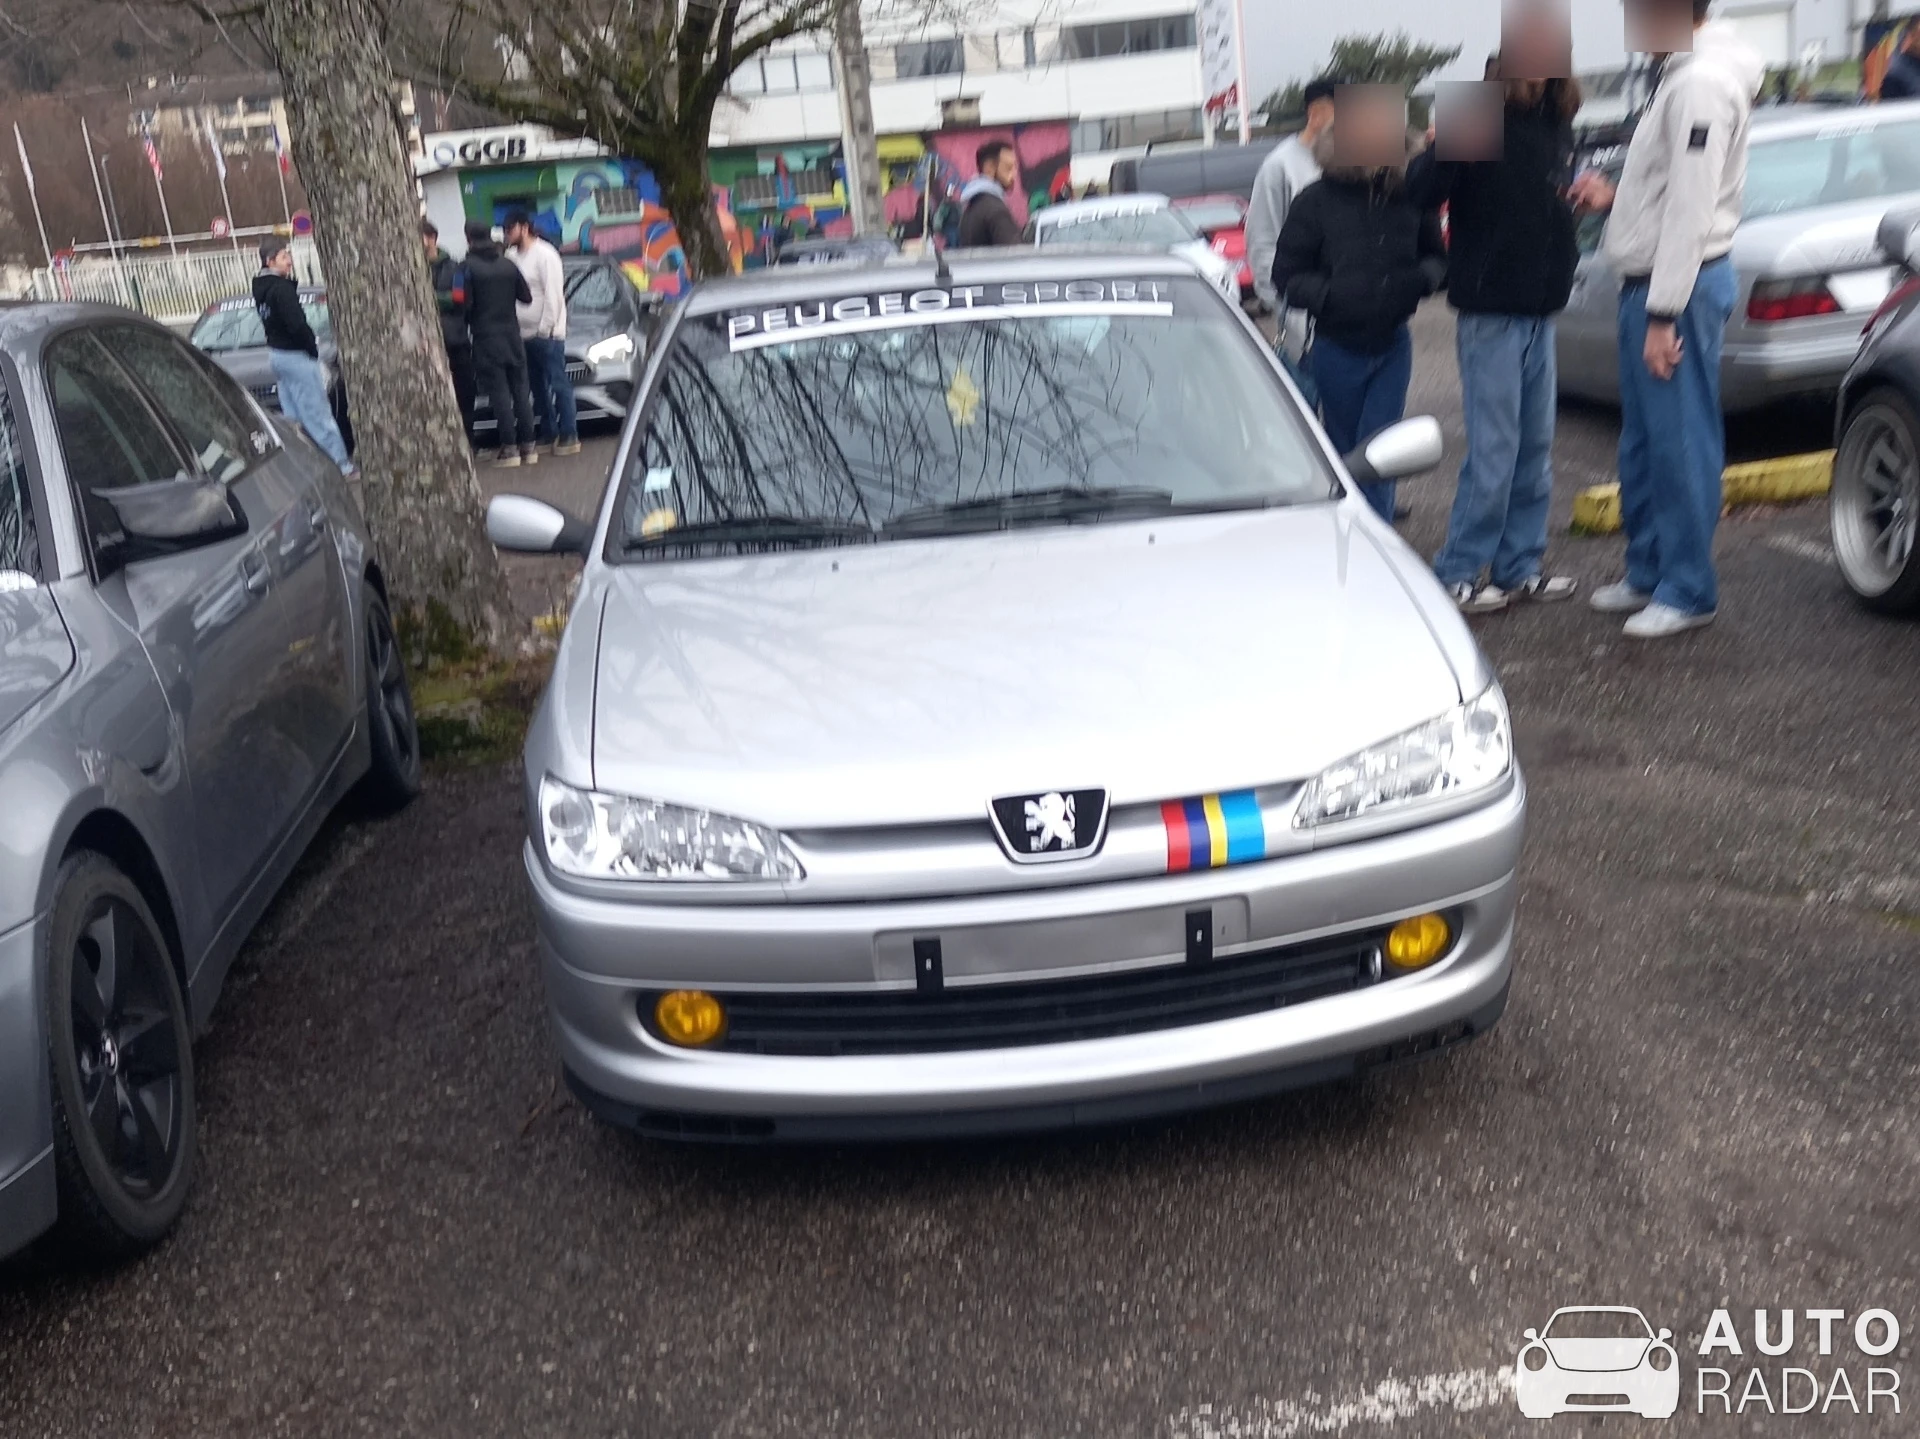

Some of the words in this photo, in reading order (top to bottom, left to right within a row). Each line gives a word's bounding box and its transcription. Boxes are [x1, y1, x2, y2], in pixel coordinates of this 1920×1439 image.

[459, 136, 527, 164] GGB
[728, 285, 984, 338] PEUGEOT
[1001, 278, 1169, 305] SPORT
